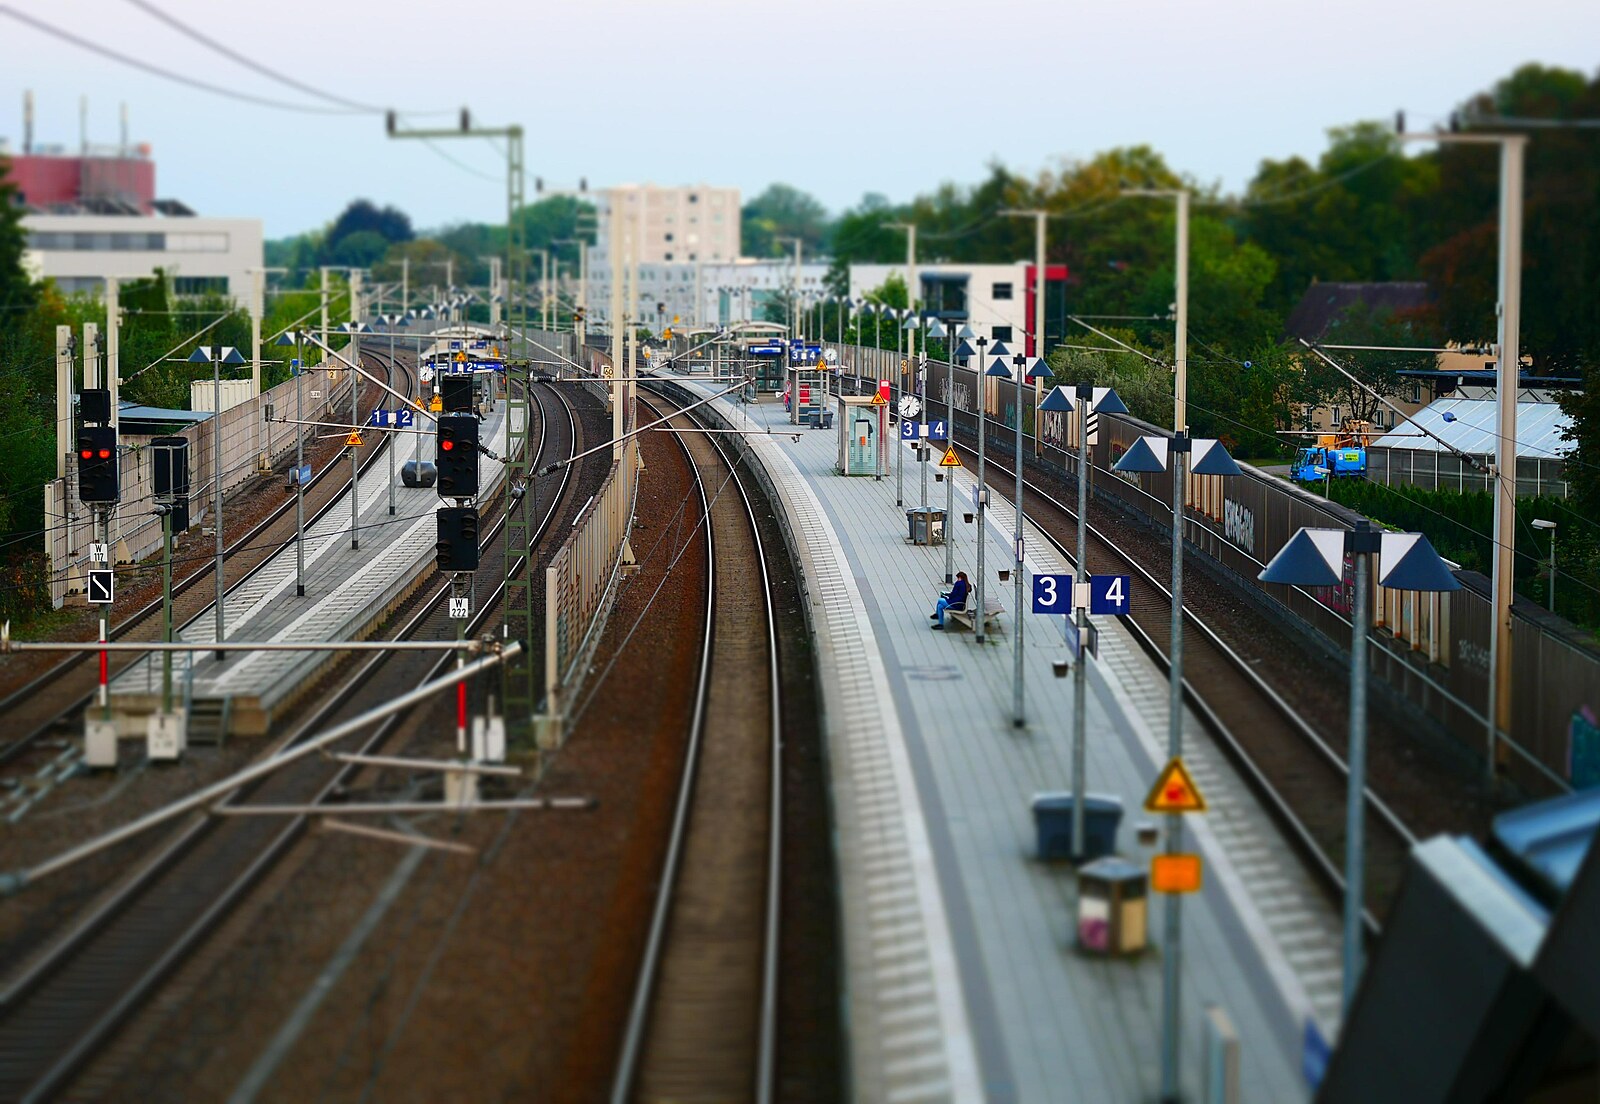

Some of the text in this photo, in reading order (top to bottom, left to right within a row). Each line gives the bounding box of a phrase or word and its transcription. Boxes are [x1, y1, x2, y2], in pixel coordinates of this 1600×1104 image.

[792, 351, 798, 359] 3
[810, 351, 816, 360] 4
[467, 362, 473, 371] 2
[374, 410, 380, 422] 1
[402, 410, 410, 422] 2
[903, 422, 913, 436] 3
[934, 422, 944, 436] 4
[95, 544, 102, 552] W
[94, 553, 104, 561] 117
[1038, 576, 1058, 606] 3
[1105, 577, 1124, 606] 4
[455, 599, 463, 608] W
[452, 608, 466, 616] 222
